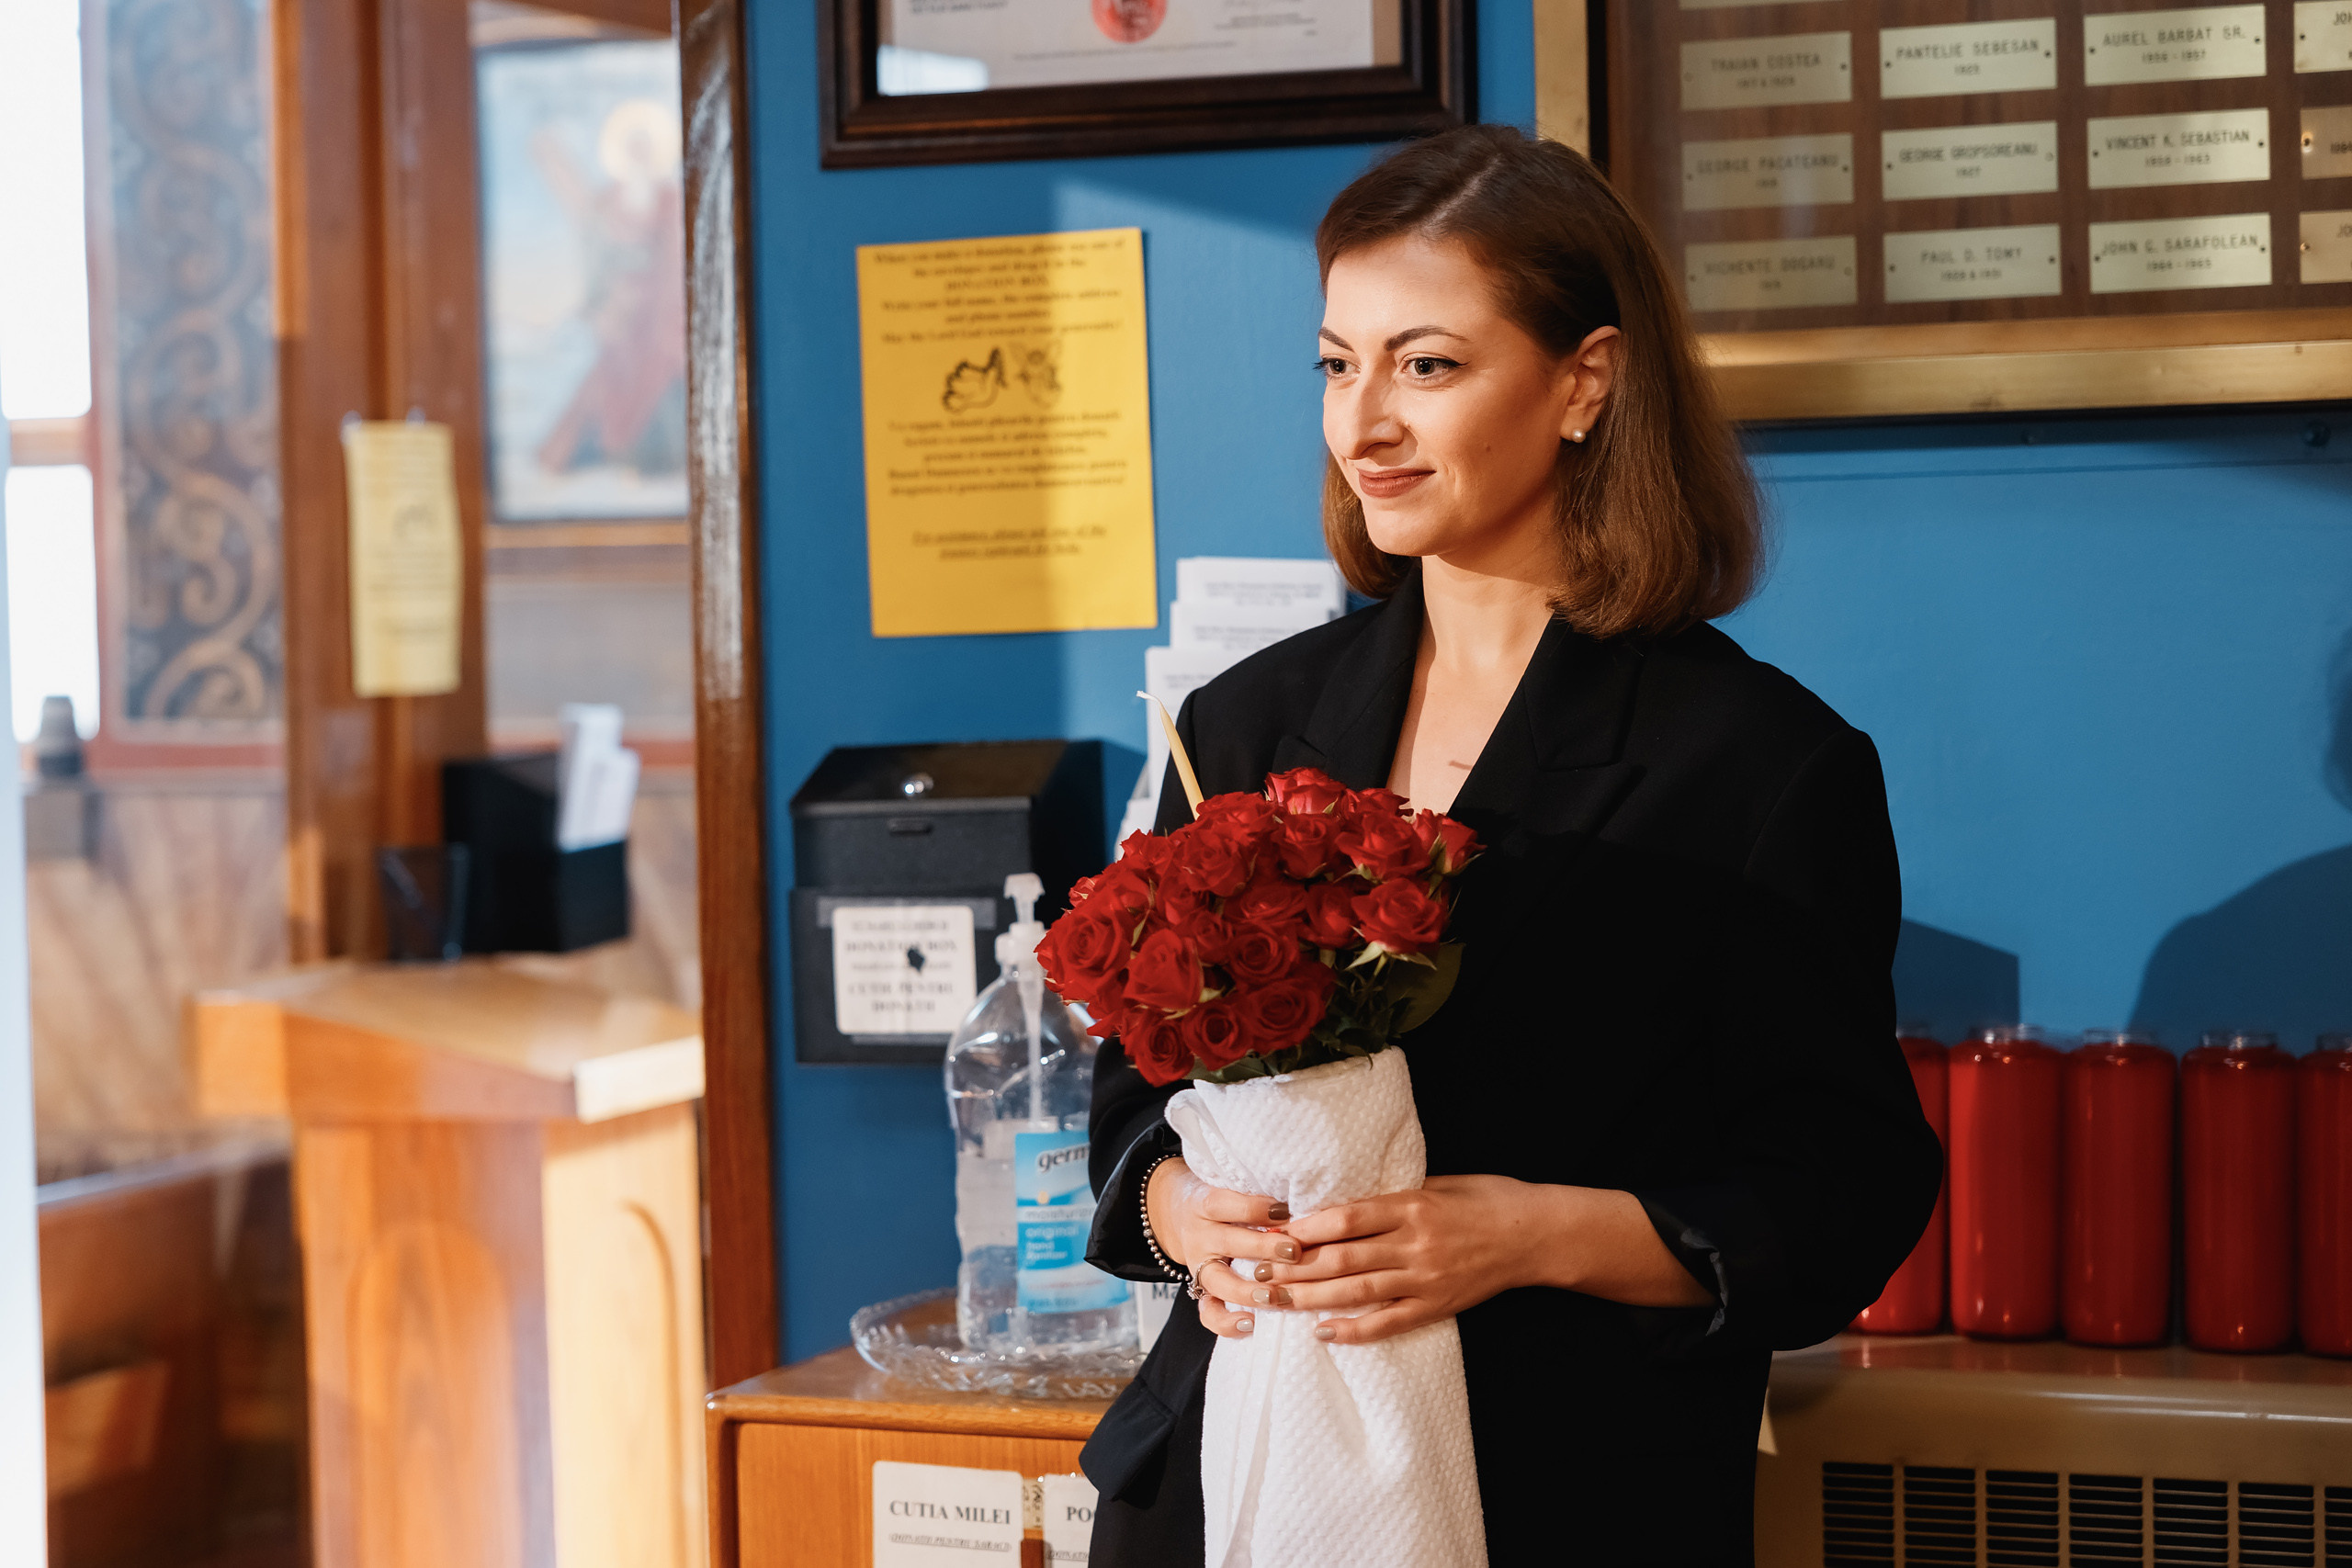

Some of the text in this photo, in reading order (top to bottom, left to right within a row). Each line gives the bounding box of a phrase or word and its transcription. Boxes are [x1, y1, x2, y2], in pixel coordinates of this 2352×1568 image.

[2103, 25, 2247, 47] AUREL BARBAT SR.
[1896, 39, 2039, 60] PANTELIE SEBESAN
[2106, 133, 2156, 151] VINCENT
[2180, 129, 2250, 148] SEBASTIAN
[1900, 146, 1944, 164] GEORGE
[2101, 240, 2138, 256] JOHN
[2165, 233, 2258, 254] SARAFOLEAN
[1920, 248, 1954, 265] PAUL
[889, 1500, 949, 1520] CUTIA
[955, 1505, 1012, 1525] MILEI
[1066, 1506, 1097, 1523] PO
